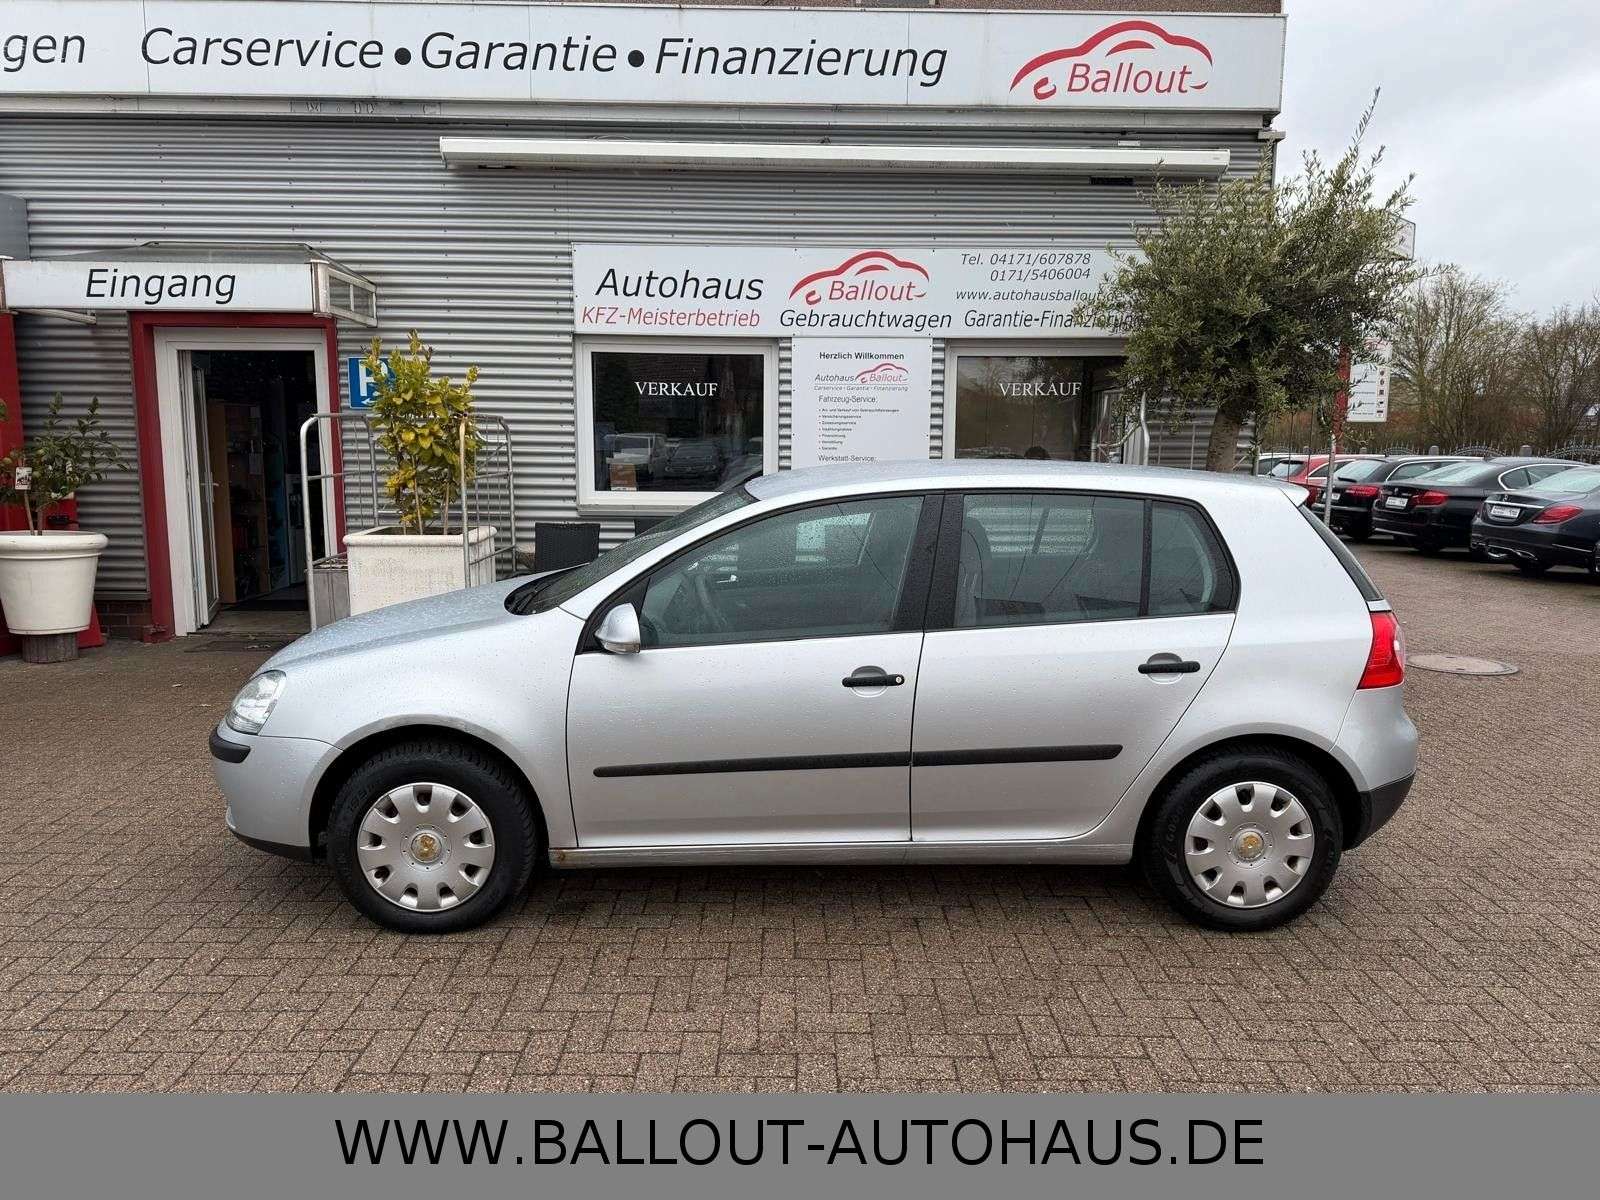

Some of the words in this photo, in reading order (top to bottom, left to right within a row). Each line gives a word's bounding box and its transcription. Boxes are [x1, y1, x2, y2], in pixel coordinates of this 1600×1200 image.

[3, 34, 85, 72] gen
[141, 27, 383, 69] Carservice
[421, 31, 617, 72] Garantie
[655, 37, 948, 88] Finanzierung
[1066, 62, 1193, 94] Ballout
[961, 253, 984, 266] Tel.
[989, 253, 1091, 266] 04171/607878
[595, 269, 764, 301] Autohaus
[990, 268, 1091, 282] 0171/5406004
[85, 269, 236, 304] Eingang
[828, 280, 918, 302] Ballout
[582, 307, 760, 327] KFZ-Meisterbetrieb
[780, 308, 952, 333] Gebrauchtwagen
[819, 351, 853, 360] Herzlich
[854, 351, 905, 361] Willkommen
[814, 373, 855, 383] Autohaus
[635, 382, 719, 398] VERKAUF
[998, 381, 1082, 397] VERKAUF
